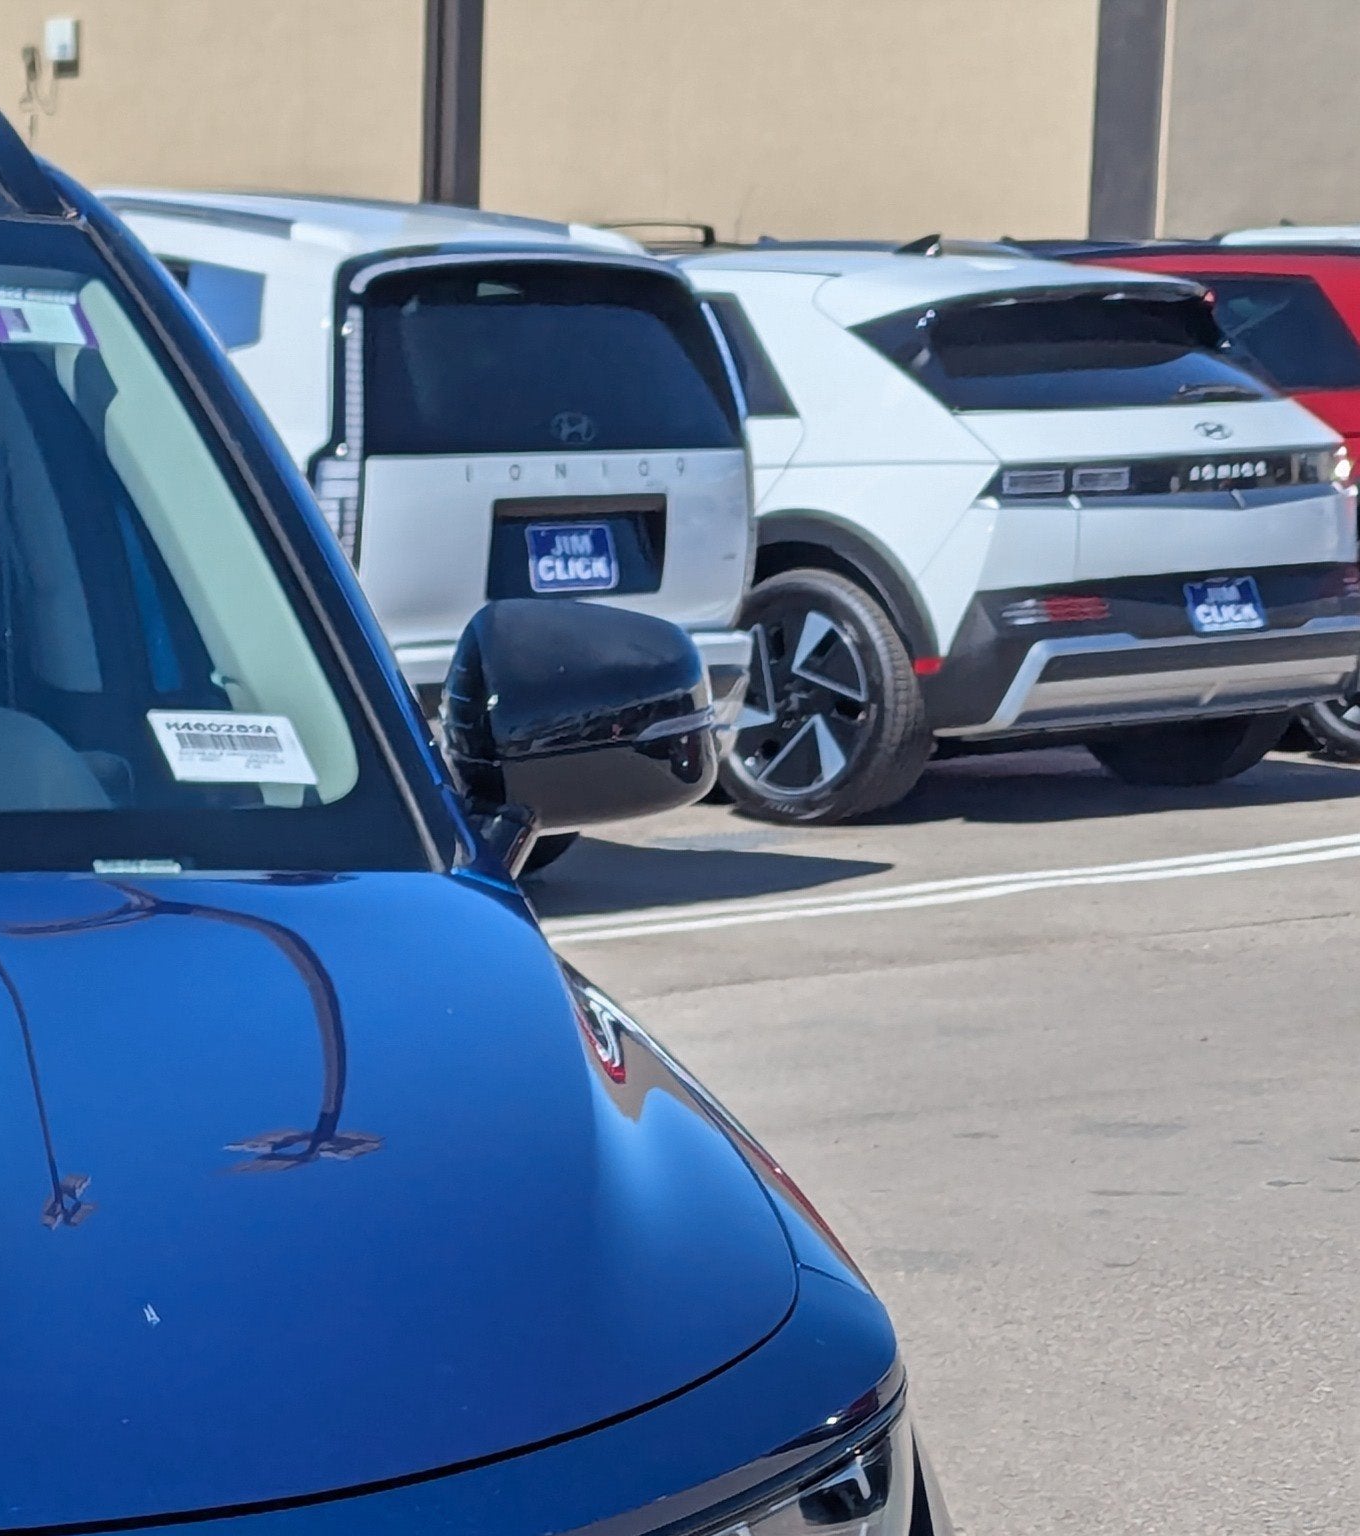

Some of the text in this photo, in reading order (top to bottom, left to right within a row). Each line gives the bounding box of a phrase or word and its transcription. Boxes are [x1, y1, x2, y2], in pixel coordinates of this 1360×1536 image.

[551, 533, 593, 556] JIM
[538, 555, 610, 581] CLICK
[1195, 602, 1259, 624] CLICK
